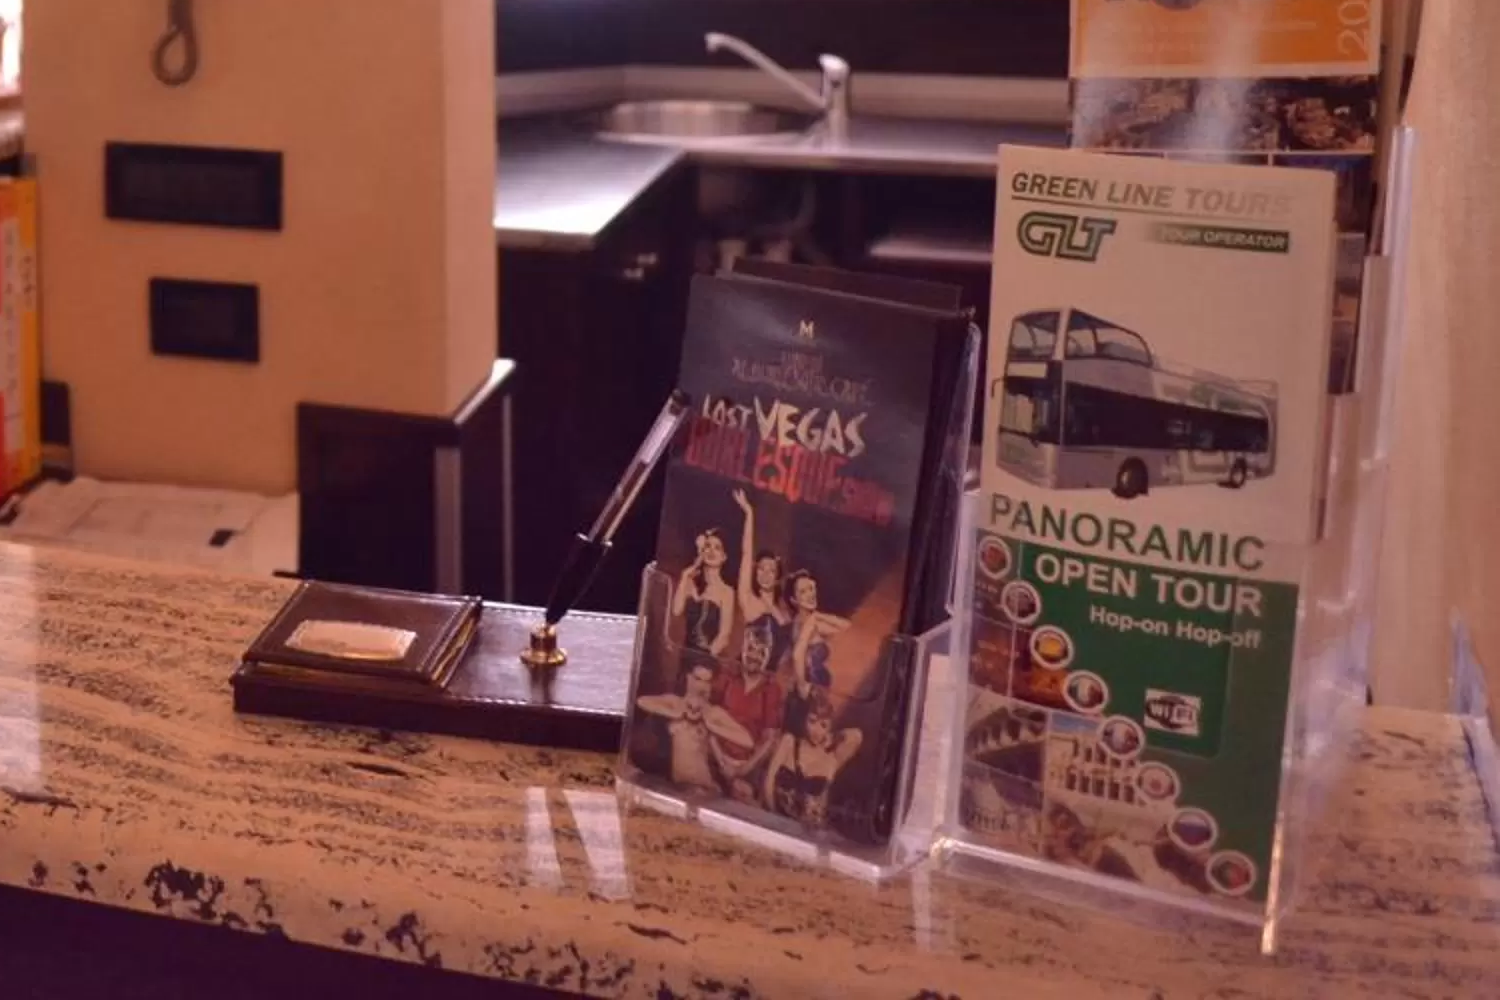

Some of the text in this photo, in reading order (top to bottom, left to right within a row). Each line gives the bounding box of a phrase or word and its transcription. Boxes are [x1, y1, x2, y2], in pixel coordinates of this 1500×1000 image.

[1012, 172, 1292, 217] GREEN LINE TOURS
[1203, 230, 1286, 249] OPERATOR
[753, 395, 869, 457] VEGAS
[990, 492, 1265, 571] PANORAMIC
[1035, 553, 1263, 617] OPEN TOUR
[1090, 604, 1262, 649] Hop-on Hop-off
